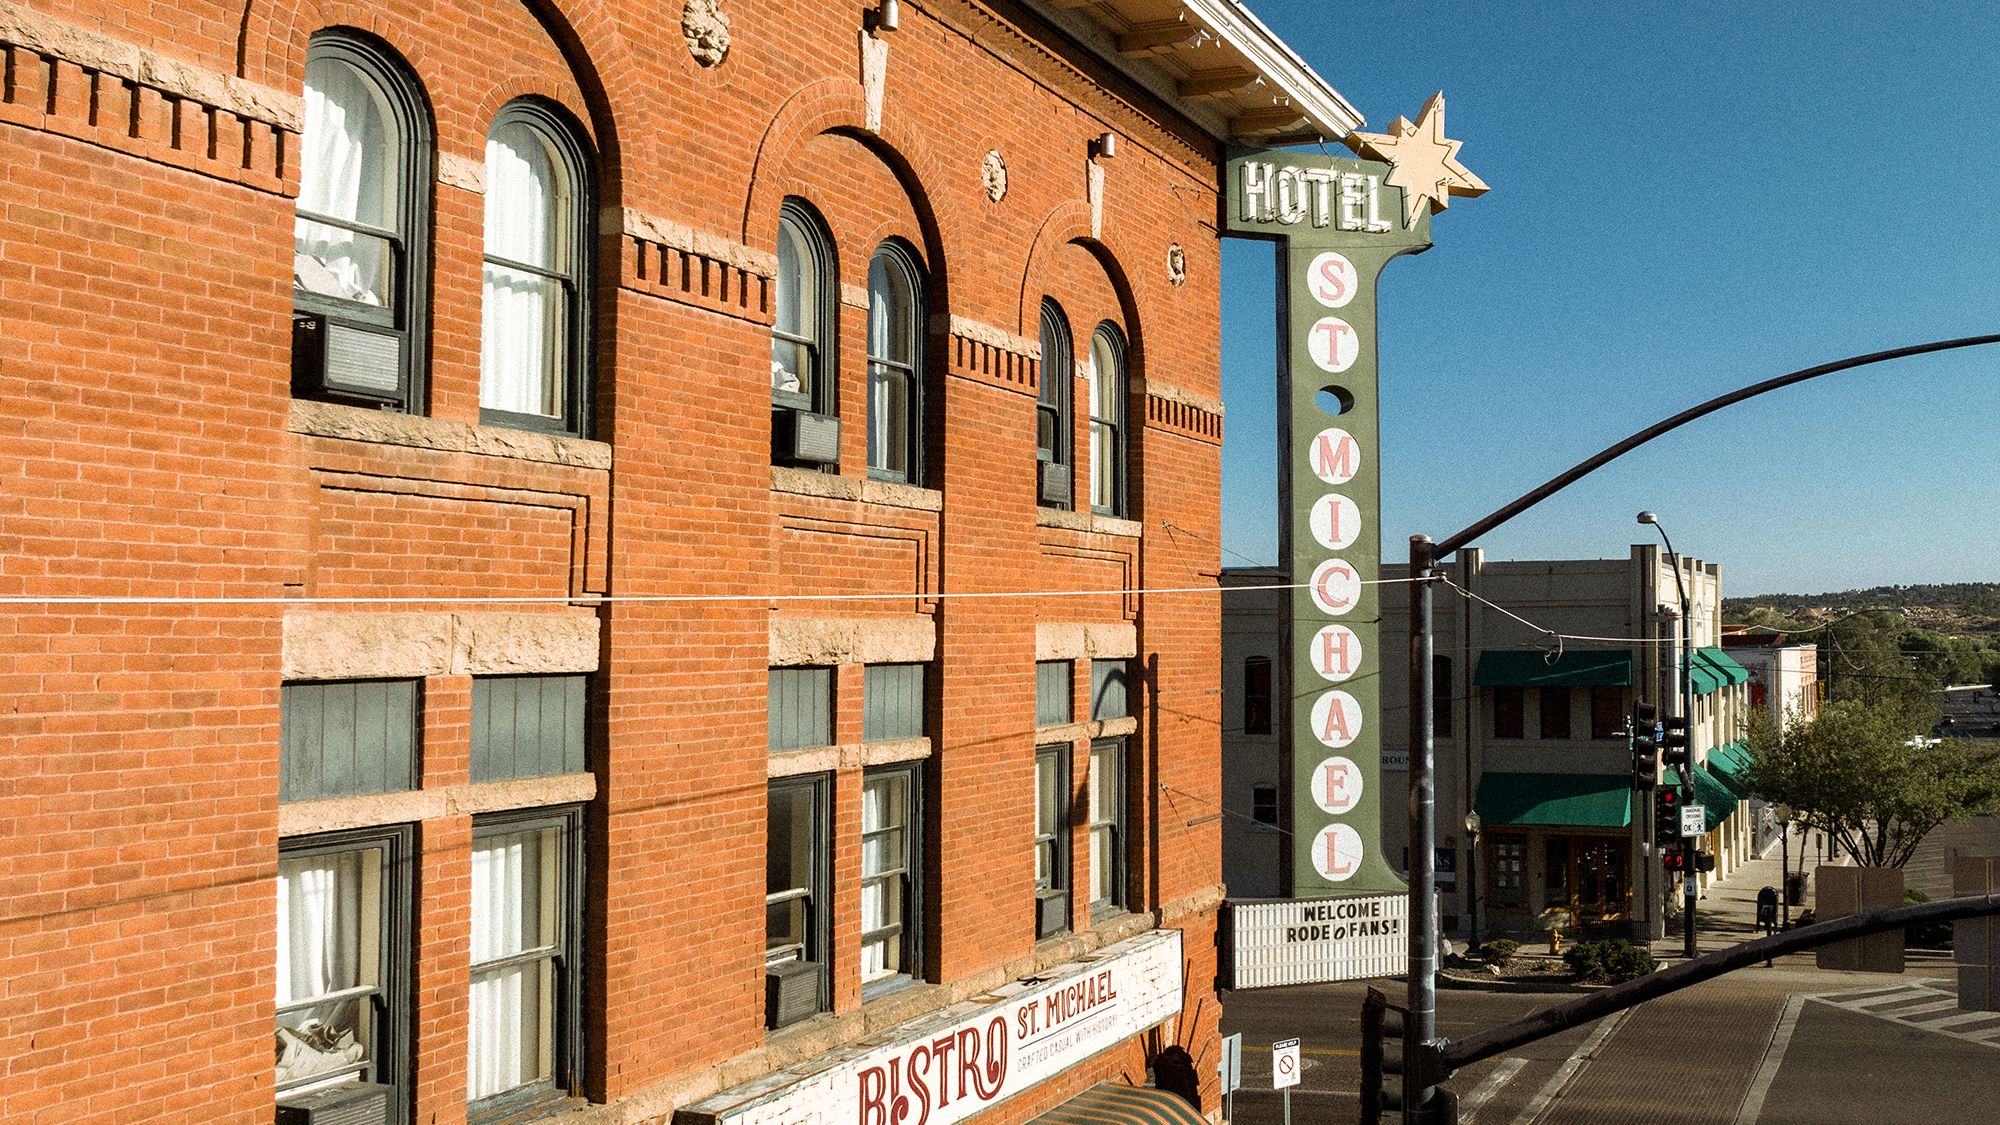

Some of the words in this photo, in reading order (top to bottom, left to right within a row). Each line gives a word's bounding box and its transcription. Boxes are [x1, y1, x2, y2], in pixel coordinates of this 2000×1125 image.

[1242, 161, 1392, 233] HOTEL
[1316, 259, 1350, 366] ST
[1317, 435, 1353, 875] MICHAEL
[1683, 824, 1692, 832] OK
[1287, 924, 1346, 943] RODEO
[1350, 919, 1398, 938] FANS!
[1304, 902, 1380, 922] WELCOME
[1017, 1000, 1040, 1040] ST.
[1046, 969, 1117, 1028] MICHAEL
[857, 1016, 1008, 1125] BISTRO
[1017, 1046, 1049, 1072] CRAFTED
[1049, 1034, 1073, 1057] CASUAL
[1075, 1025, 1091, 1044] WITH
